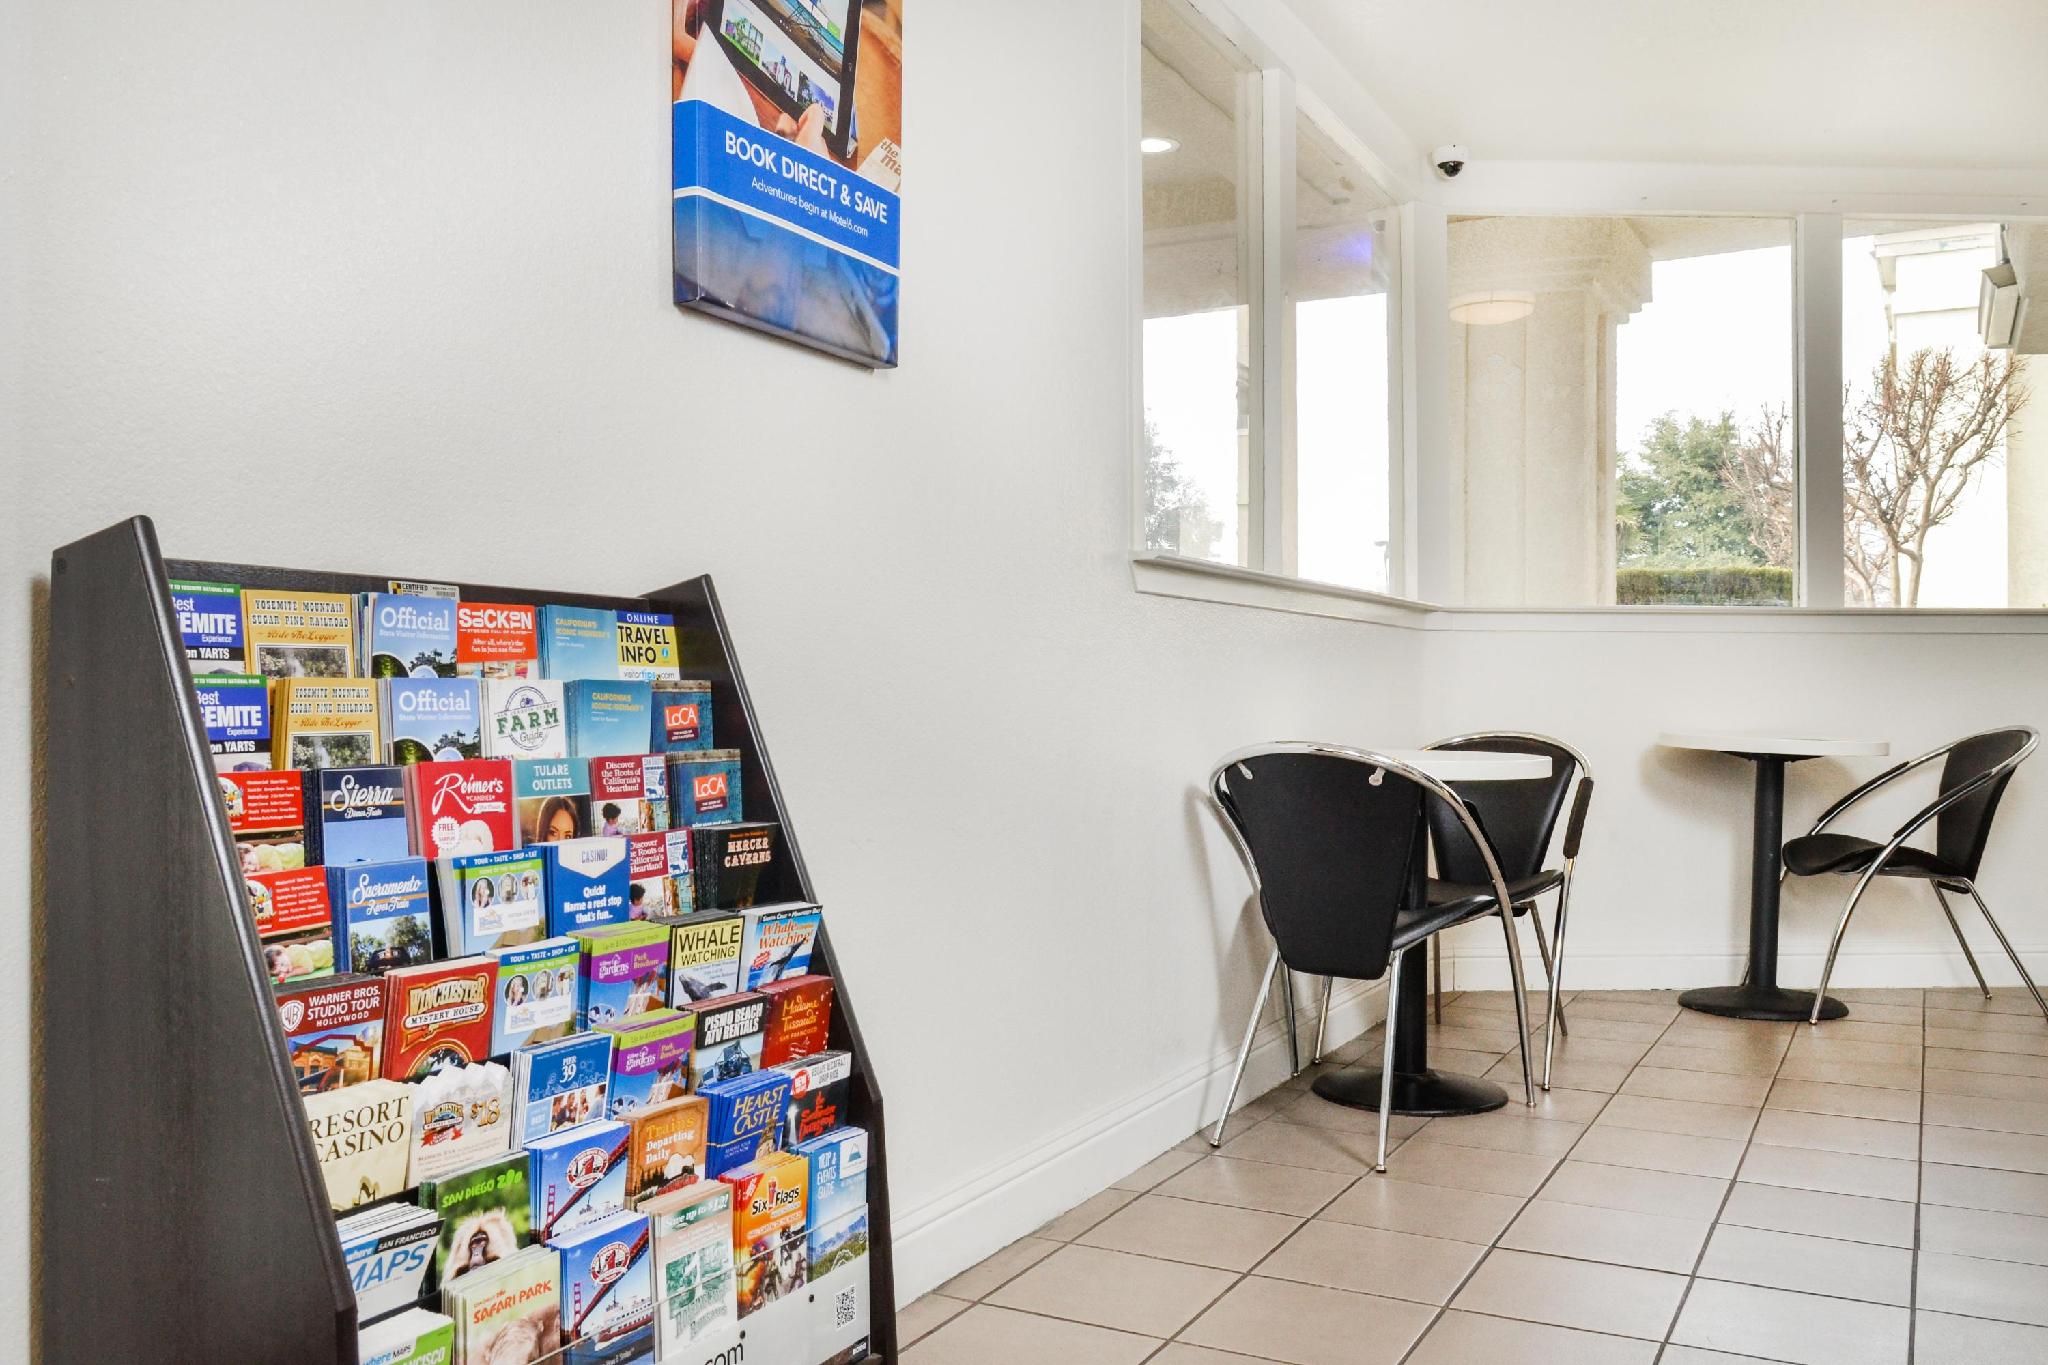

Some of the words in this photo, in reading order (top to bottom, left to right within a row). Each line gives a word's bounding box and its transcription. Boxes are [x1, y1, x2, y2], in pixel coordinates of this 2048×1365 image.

[880, 141, 898, 158] the
[725, 130, 777, 173] BOOK
[781, 156, 837, 199] DIRECT
[840, 184, 851, 207] &
[854, 191, 888, 224] SAVE
[752, 176, 797, 205] Adventures
[799, 197, 819, 216] begin
[820, 209, 828, 217] at
[829, 210, 868, 237] Motel6.com
[402, 583, 429, 591] CERTIFIED
[255, 600, 298, 611] YOSEMITE
[303, 601, 344, 612] MOUNTAIN
[177, 612, 237, 635] EMITE
[252, 615, 280, 625] SUGAR
[285, 615, 305, 626] PINE
[309, 616, 349, 627] RAILROAD
[381, 606, 450, 631] Official
[626, 613, 659, 624] ONLINE
[201, 634, 232, 644] Experience
[618, 625, 670, 645] TRAVEL
[199, 647, 230, 659] YARTS
[620, 645, 657, 664] INFO
[295, 687, 328, 698] YOSEMITE
[332, 688, 369, 698] MOUNTAIN
[399, 689, 471, 712] Official
[200, 705, 262, 728] EMITE
[290, 703, 312, 713] SUGAR
[316, 703, 332, 713] PINE
[337, 703, 374, 713] RAILROAD
[496, 707, 559, 735] FARM
[226, 727, 258, 737] Experience
[520, 728, 544, 743] Guide
[224, 740, 256, 752] YARTS
[533, 764, 569, 777] TULARE
[601, 769, 613, 777] the
[614, 768, 634, 776] Roots
[635, 767, 641, 776] of
[605, 761, 636, 769] Discover
[532, 777, 573, 791] OUTLETS
[602, 775, 641, 785] California's
[606, 785, 639, 793] Heartland
[330, 774, 394, 812] Sierra
[432, 773, 504, 816] Reimer's
[438, 823, 455, 831] FREE
[638, 847, 658, 857] Roots
[658, 845, 665, 853] of
[727, 837, 769, 853] MERCER
[512, 852, 525, 860] SHOP
[581, 848, 608, 864] CASINO!
[630, 854, 665, 865] alifornia's
[724, 850, 772, 868] CAVERNS
[630, 862, 663, 874] Heartland
[352, 873, 422, 905] Sacramento
[563, 901, 586, 913] Name
[587, 901, 593, 909] a
[593, 897, 607, 908] rest
[608, 896, 622, 907] stop
[575, 911, 596, 923] that's
[763, 921, 799, 936] Whale
[679, 925, 740, 953] WHALE
[510, 955, 525, 963] TOUR
[530, 951, 546, 960] TASTE
[681, 946, 736, 966] WATCHING
[308, 990, 352, 1007] WARNER
[353, 985, 380, 999] BROS.
[409, 976, 485, 1016] WINCHESTER
[782, 995, 819, 1016] Madame
[307, 1002, 348, 1020] STUDIO
[351, 996, 380, 1011] TOUR
[411, 1011, 450, 1025] MYSTERY
[453, 1004, 480, 1016] HOUSE
[704, 1010, 734, 1032] PISMO
[734, 1002, 764, 1023] BEACH
[316, 1011, 370, 1027] HOLLYWOOD
[781, 1009, 817, 1032] Tussauds
[704, 1027, 723, 1046] ATV
[722, 1017, 760, 1040] RENTALS
[562, 1055, 577, 1066] PIER
[560, 1063, 577, 1083] 39
[733, 1084, 788, 1117] HEARST
[310, 1095, 409, 1139] RESORT
[471, 1097, 501, 1128] $18
[734, 1104, 782, 1135] CASTLE
[646, 1118, 696, 1140] Trains
[646, 1130, 696, 1152] Departing
[645, 1149, 671, 1165] Daily
[817, 1165, 837, 1186] EVENTS
[441, 1190, 465, 1208] SAN
[465, 1179, 495, 1200] DIEGO
[751, 1199, 768, 1215] Six
[775, 1187, 800, 1206] Flags
[685, 1209, 697, 1221] up
[697, 1206, 706, 1215] to
[378, 1240, 393, 1251] SAN
[394, 1227, 437, 1247] FRANCISCO
[473, 1294, 516, 1324] SAFARI
[519, 1280, 553, 1303] PARK
[704, 1343, 744, 1365] om
